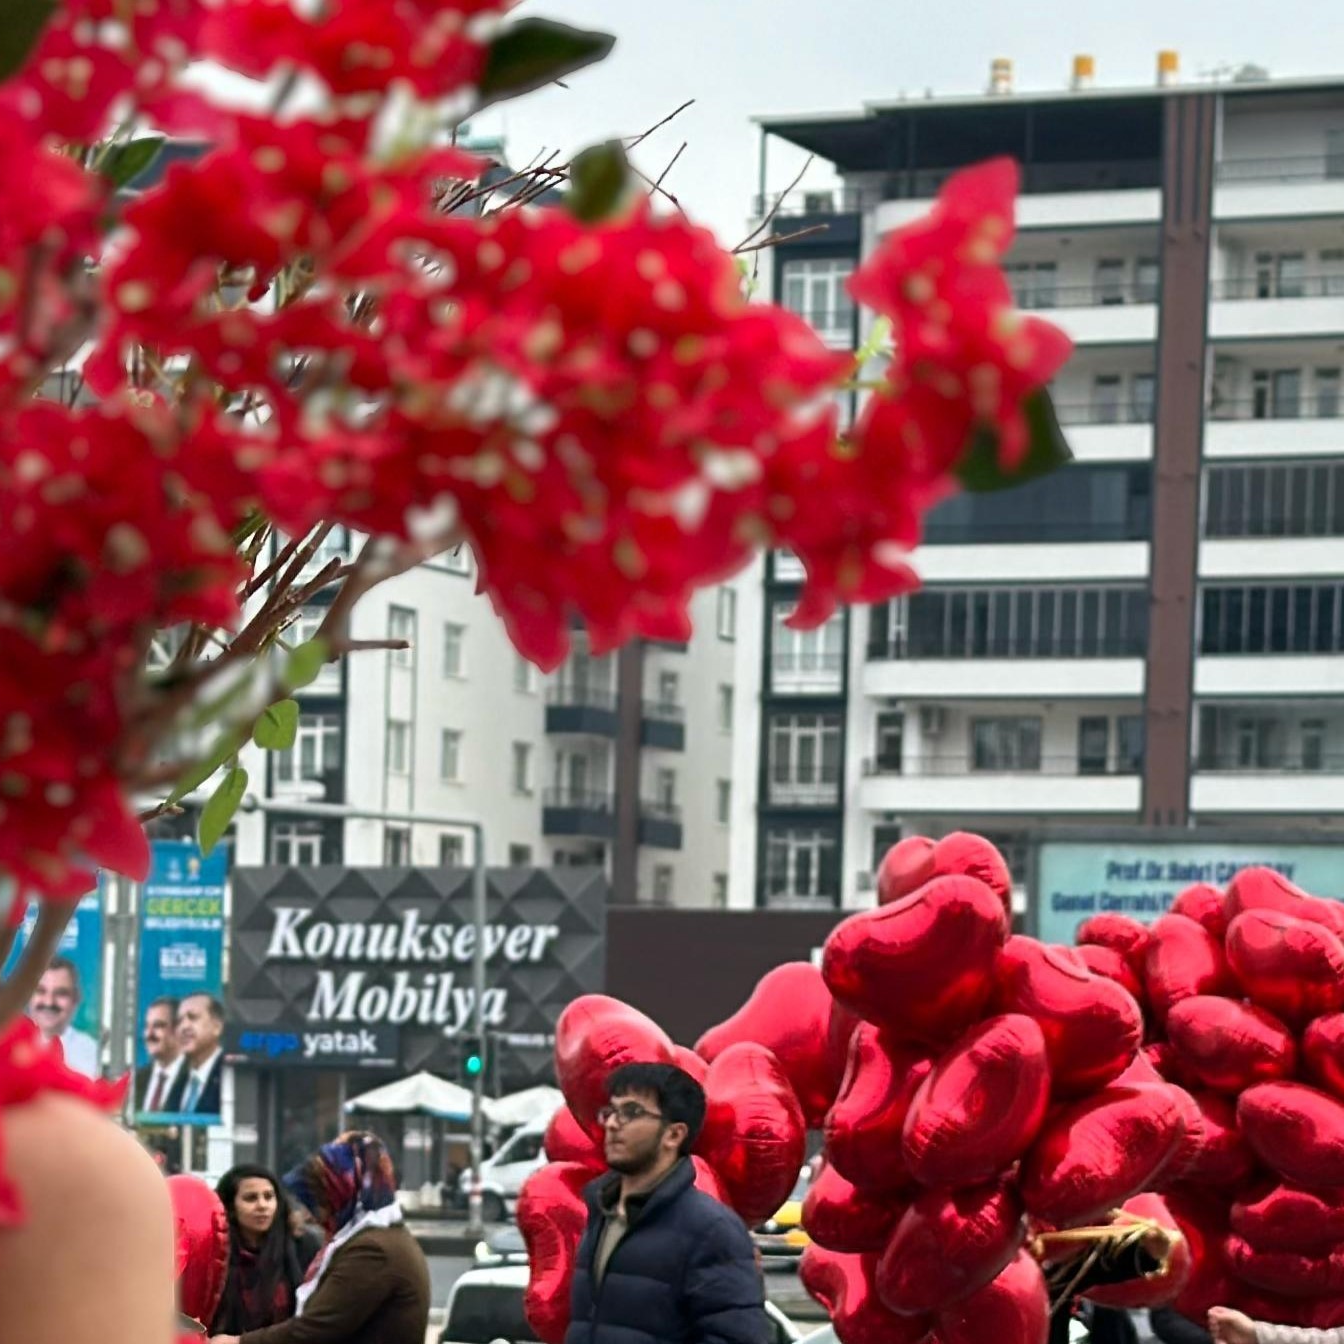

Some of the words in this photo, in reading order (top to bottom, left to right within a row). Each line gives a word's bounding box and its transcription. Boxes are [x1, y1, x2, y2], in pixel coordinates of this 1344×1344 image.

[267, 906, 559, 961] Konuksever
[307, 970, 507, 1037] Mobilya
[302, 1028, 378, 1058] yatak
